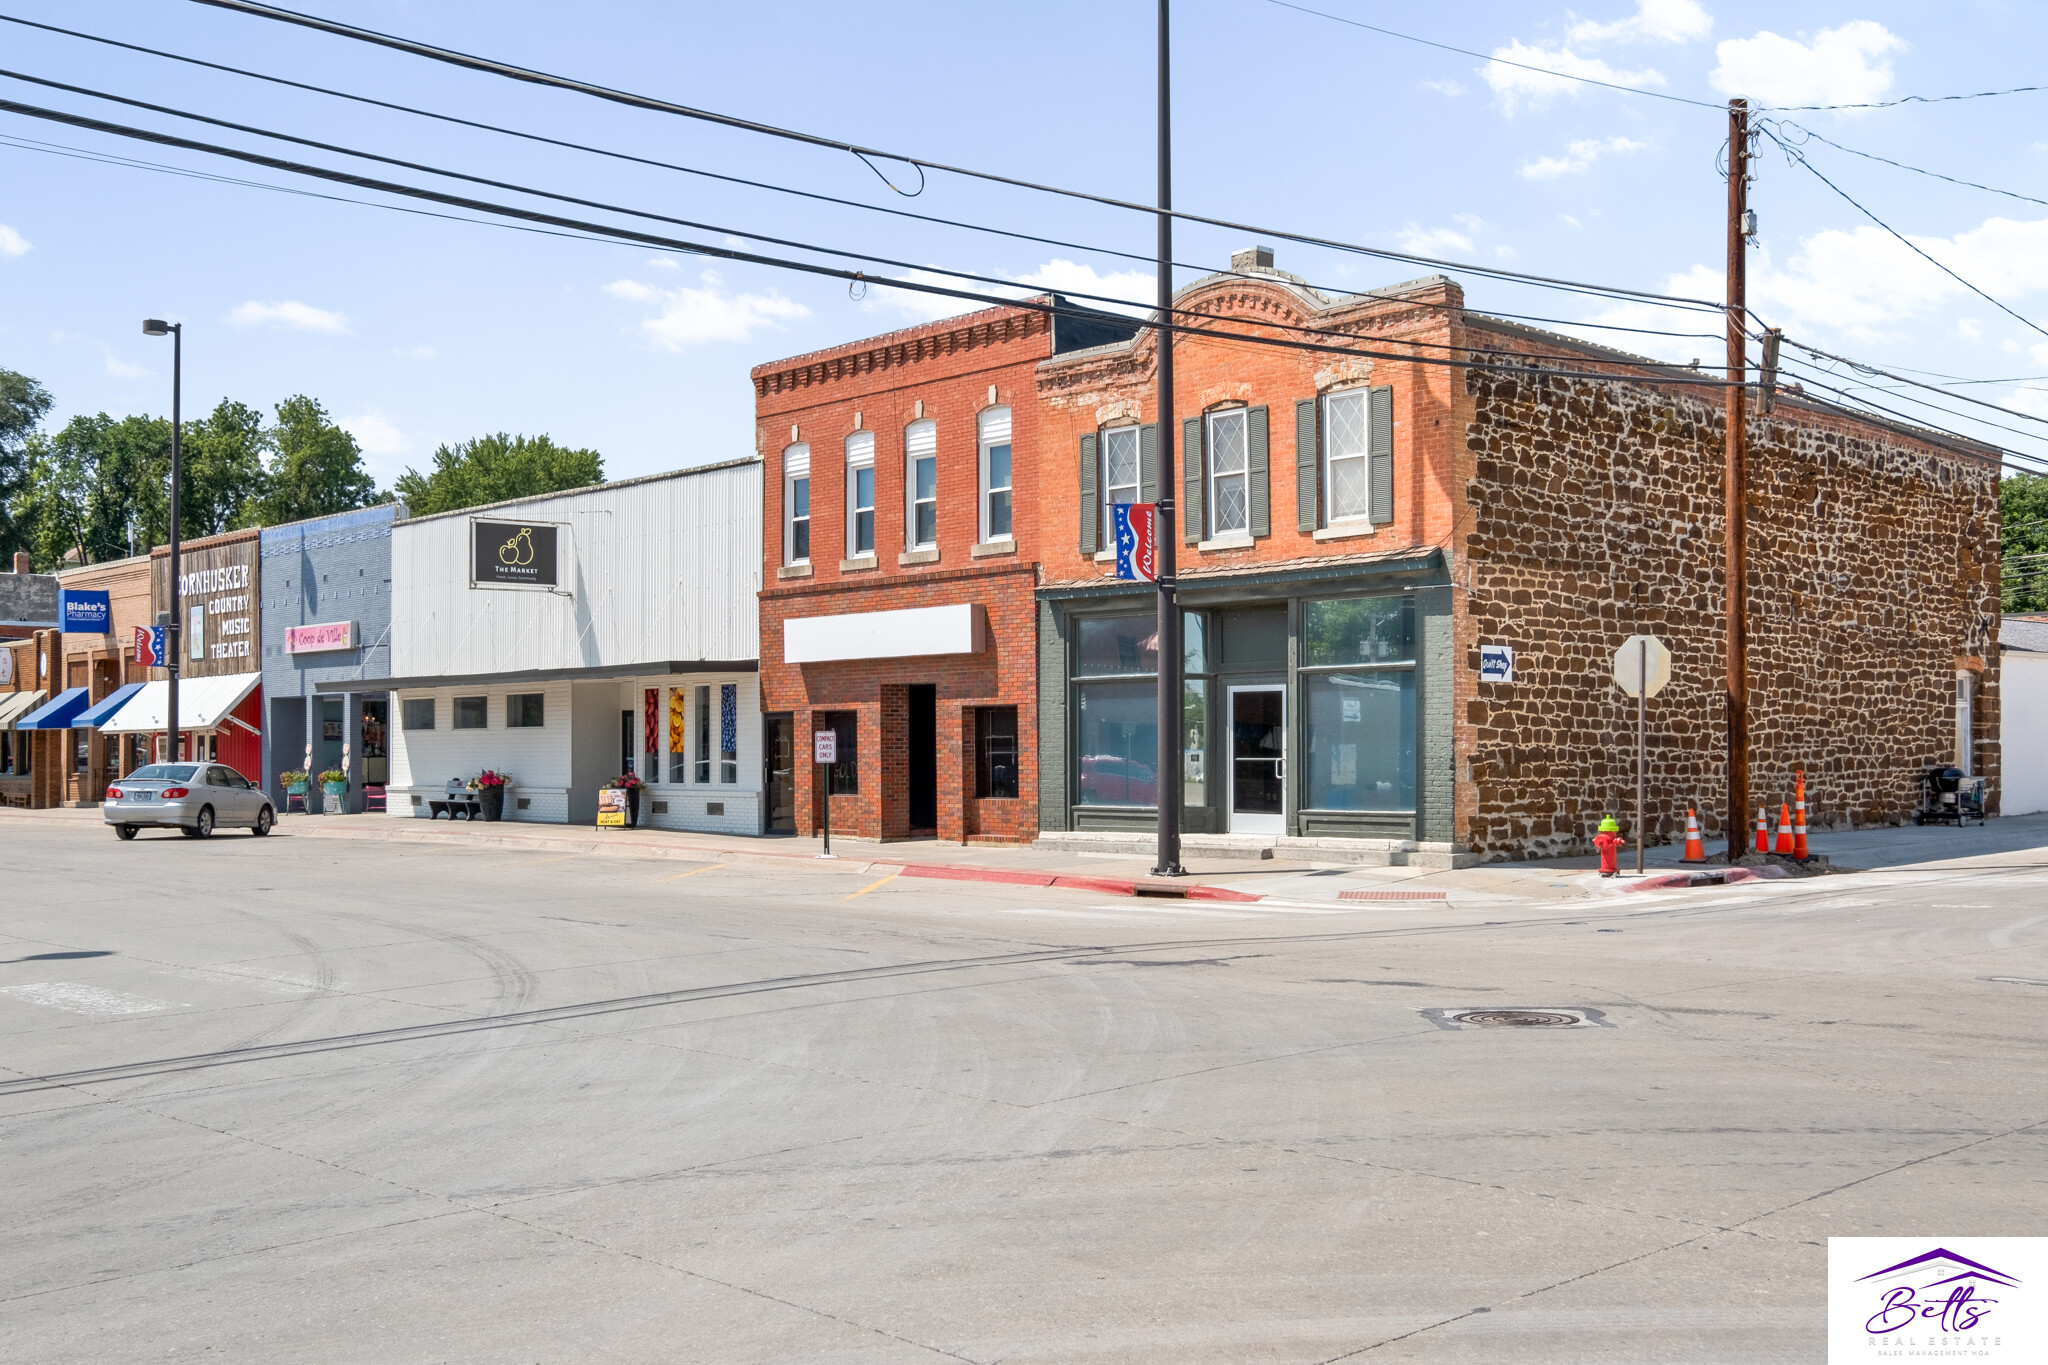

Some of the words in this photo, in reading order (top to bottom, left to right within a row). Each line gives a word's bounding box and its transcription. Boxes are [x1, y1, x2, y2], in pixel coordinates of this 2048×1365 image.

[1143, 511, 1153, 574] Welcome
[495, 565, 509, 573] THE
[510, 566, 538, 574] MARKET
[178, 564, 249, 597] ORNHUSKER
[66, 602, 107, 611] Blake's
[209, 594, 249, 615] COUNTRY
[66, 610, 106, 620] Pharmacy
[222, 617, 250, 636] MUSIC
[298, 632, 315, 648] Coop
[317, 628, 325, 643] de
[326, 627, 342, 642] Ville
[211, 640, 250, 659] THEATER
